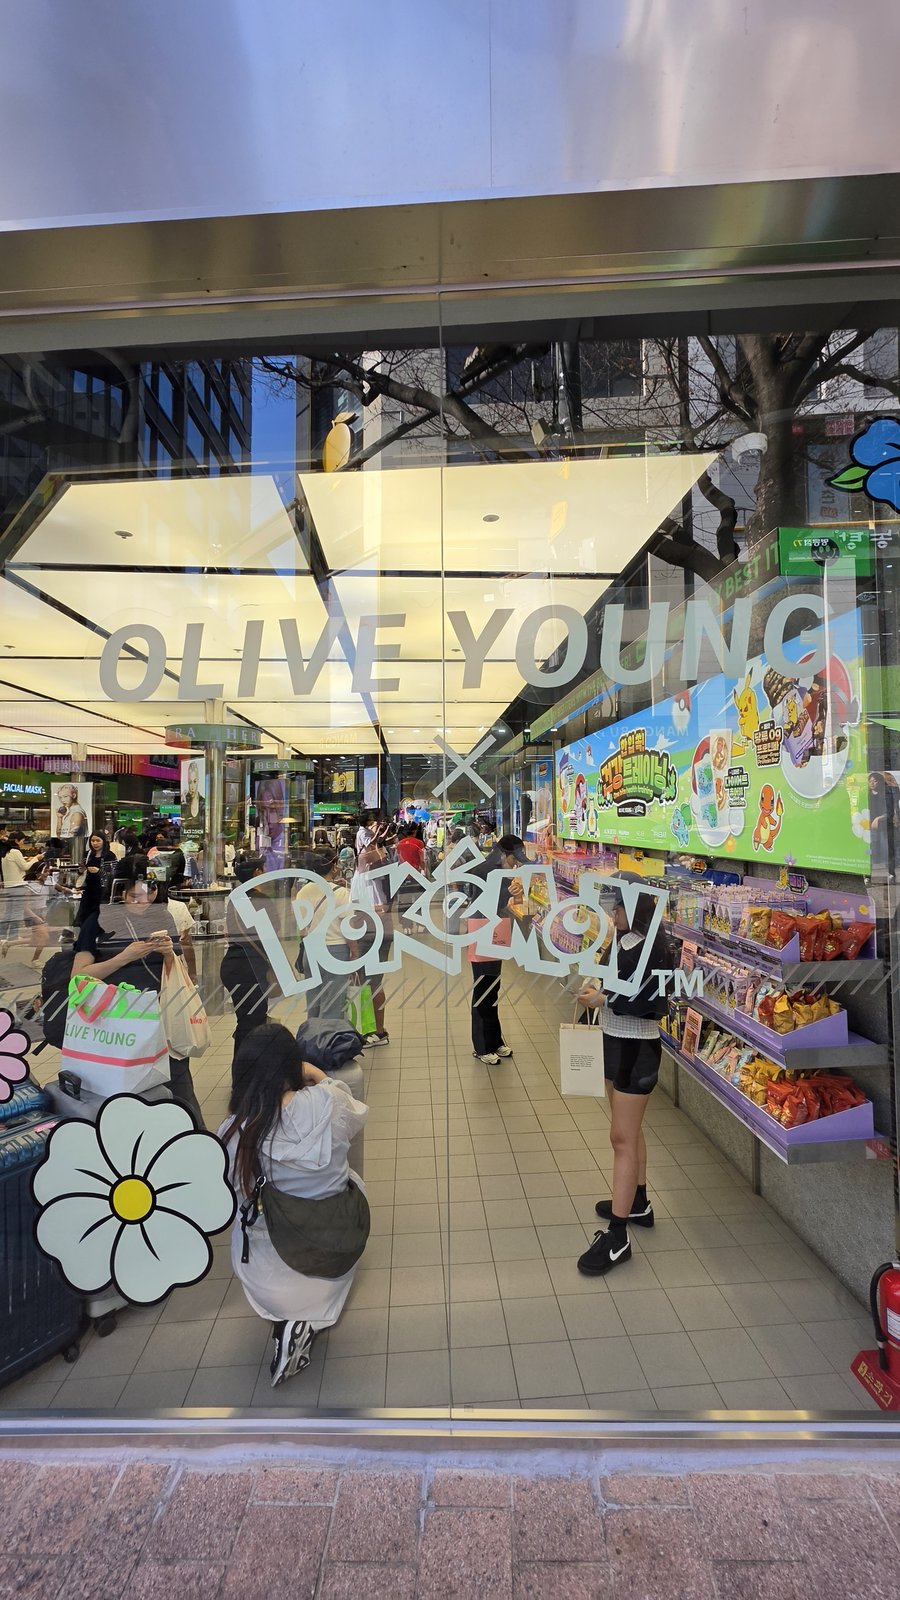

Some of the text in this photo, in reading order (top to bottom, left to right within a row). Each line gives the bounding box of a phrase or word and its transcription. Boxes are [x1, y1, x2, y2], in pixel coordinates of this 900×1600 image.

[725, 554, 761, 598] BEST
[99, 593, 834, 702] OLIVE YOUNG
[3, 783, 43, 794] FACIAL MASK
[601, 753, 668, 797] 건강 트레이닝
[652, 969, 705, 997] TM
[92, 1028, 136, 1047] YOUNG
[865, 1371, 893, 1406] 소화기
